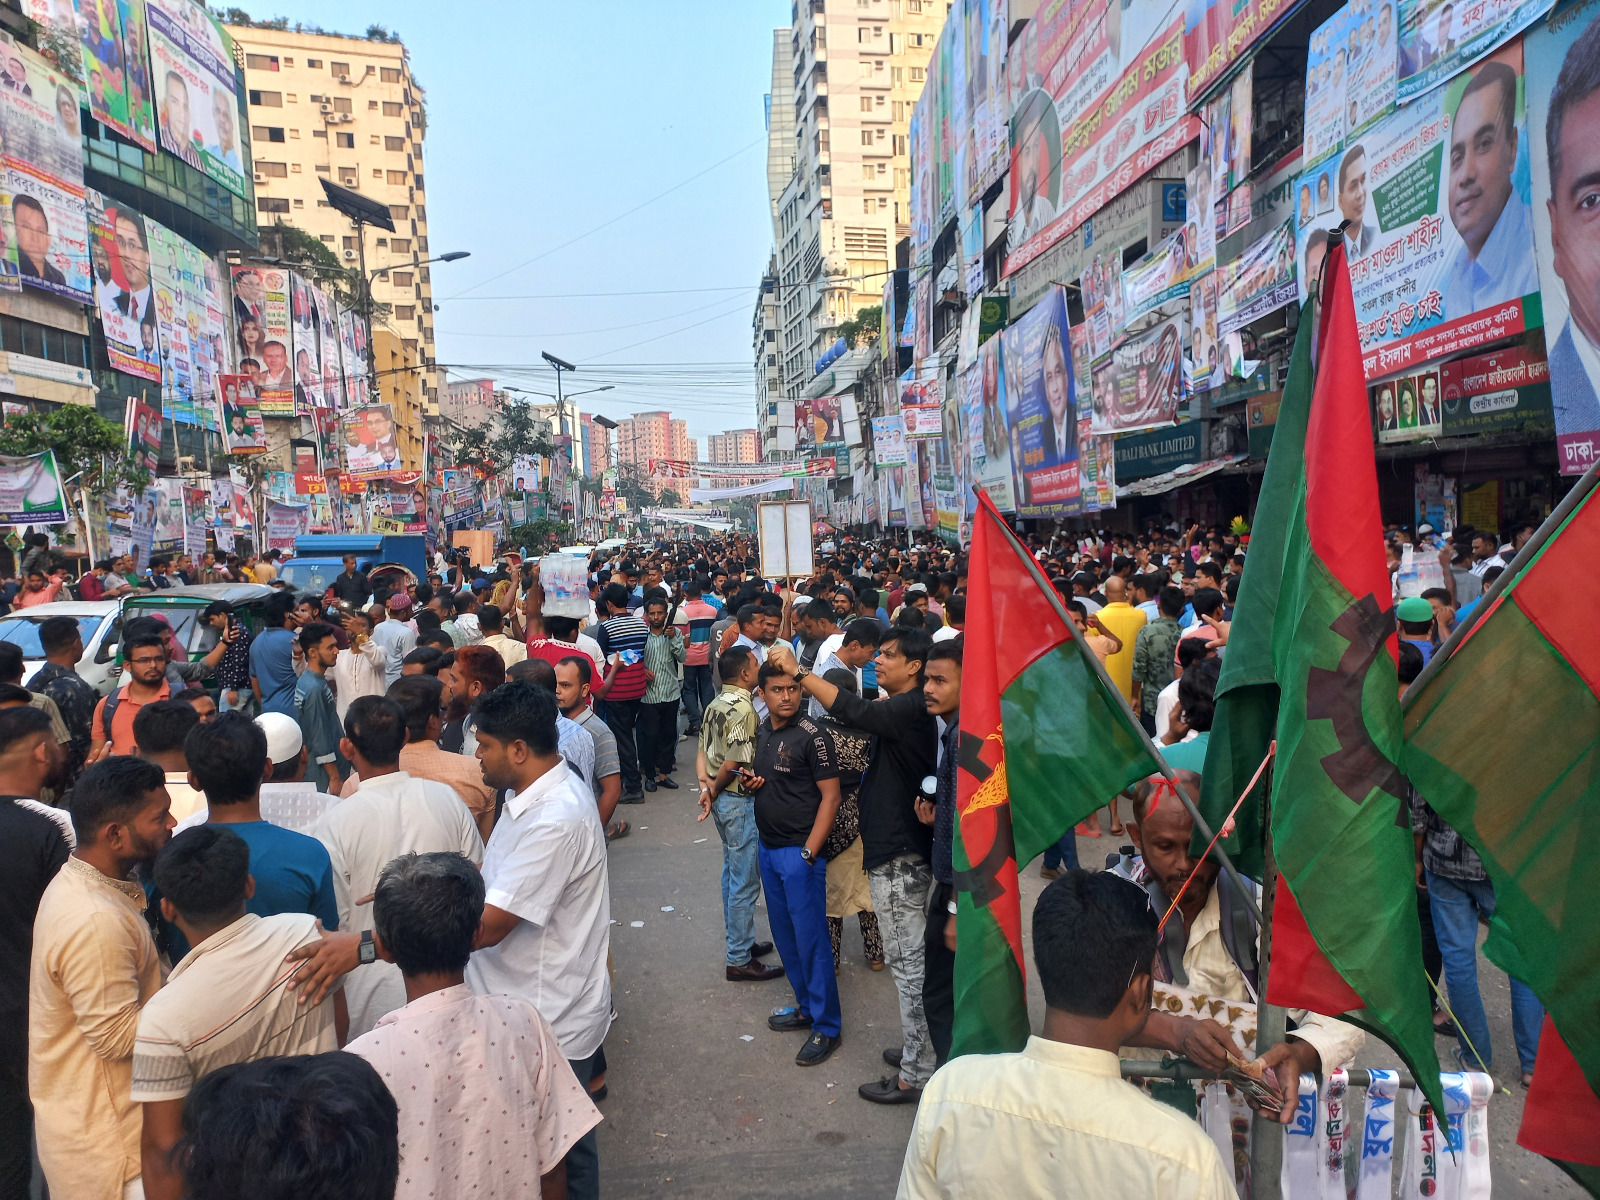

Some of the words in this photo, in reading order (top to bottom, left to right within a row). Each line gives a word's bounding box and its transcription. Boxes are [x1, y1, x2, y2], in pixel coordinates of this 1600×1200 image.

[1143, 78, 1180, 134] চাই
[1370, 155, 1390, 181] বেগম
[1392, 135, 1418, 162] খালেদা
[1420, 125, 1440, 147] জিয়া
[1347, 256, 1370, 282] লাম
[1371, 238, 1404, 269] মাওলা
[1406, 216, 1442, 251] শাহীন
[1361, 297, 1379, 314] সকল
[1379, 290, 1394, 307] রাজ
[1396, 277, 1417, 299] বন্দীর
[1390, 301, 1416, 337] মুক্তি
[1417, 289, 1442, 319] চাই
[1362, 355, 1378, 380] ফুল
[1379, 342, 1412, 370] ইসলাম
[1415, 336, 1435, 350] সাবেক
[1494, 305, 1519, 324] কমিটি
[1462, 372, 1487, 391] বাংলাদেশ
[1489, 360, 1526, 387] জাতীয়তাবাদী
[1138, 442, 1159, 459] BANK
[1161, 435, 1195, 455] LIMITED
[814, 736, 828, 761] GETUP
[1289, 1092, 1317, 1139] দল
[1326, 1102, 1343, 1153] শ্রমিক
[1420, 1131, 1437, 1180] দল
